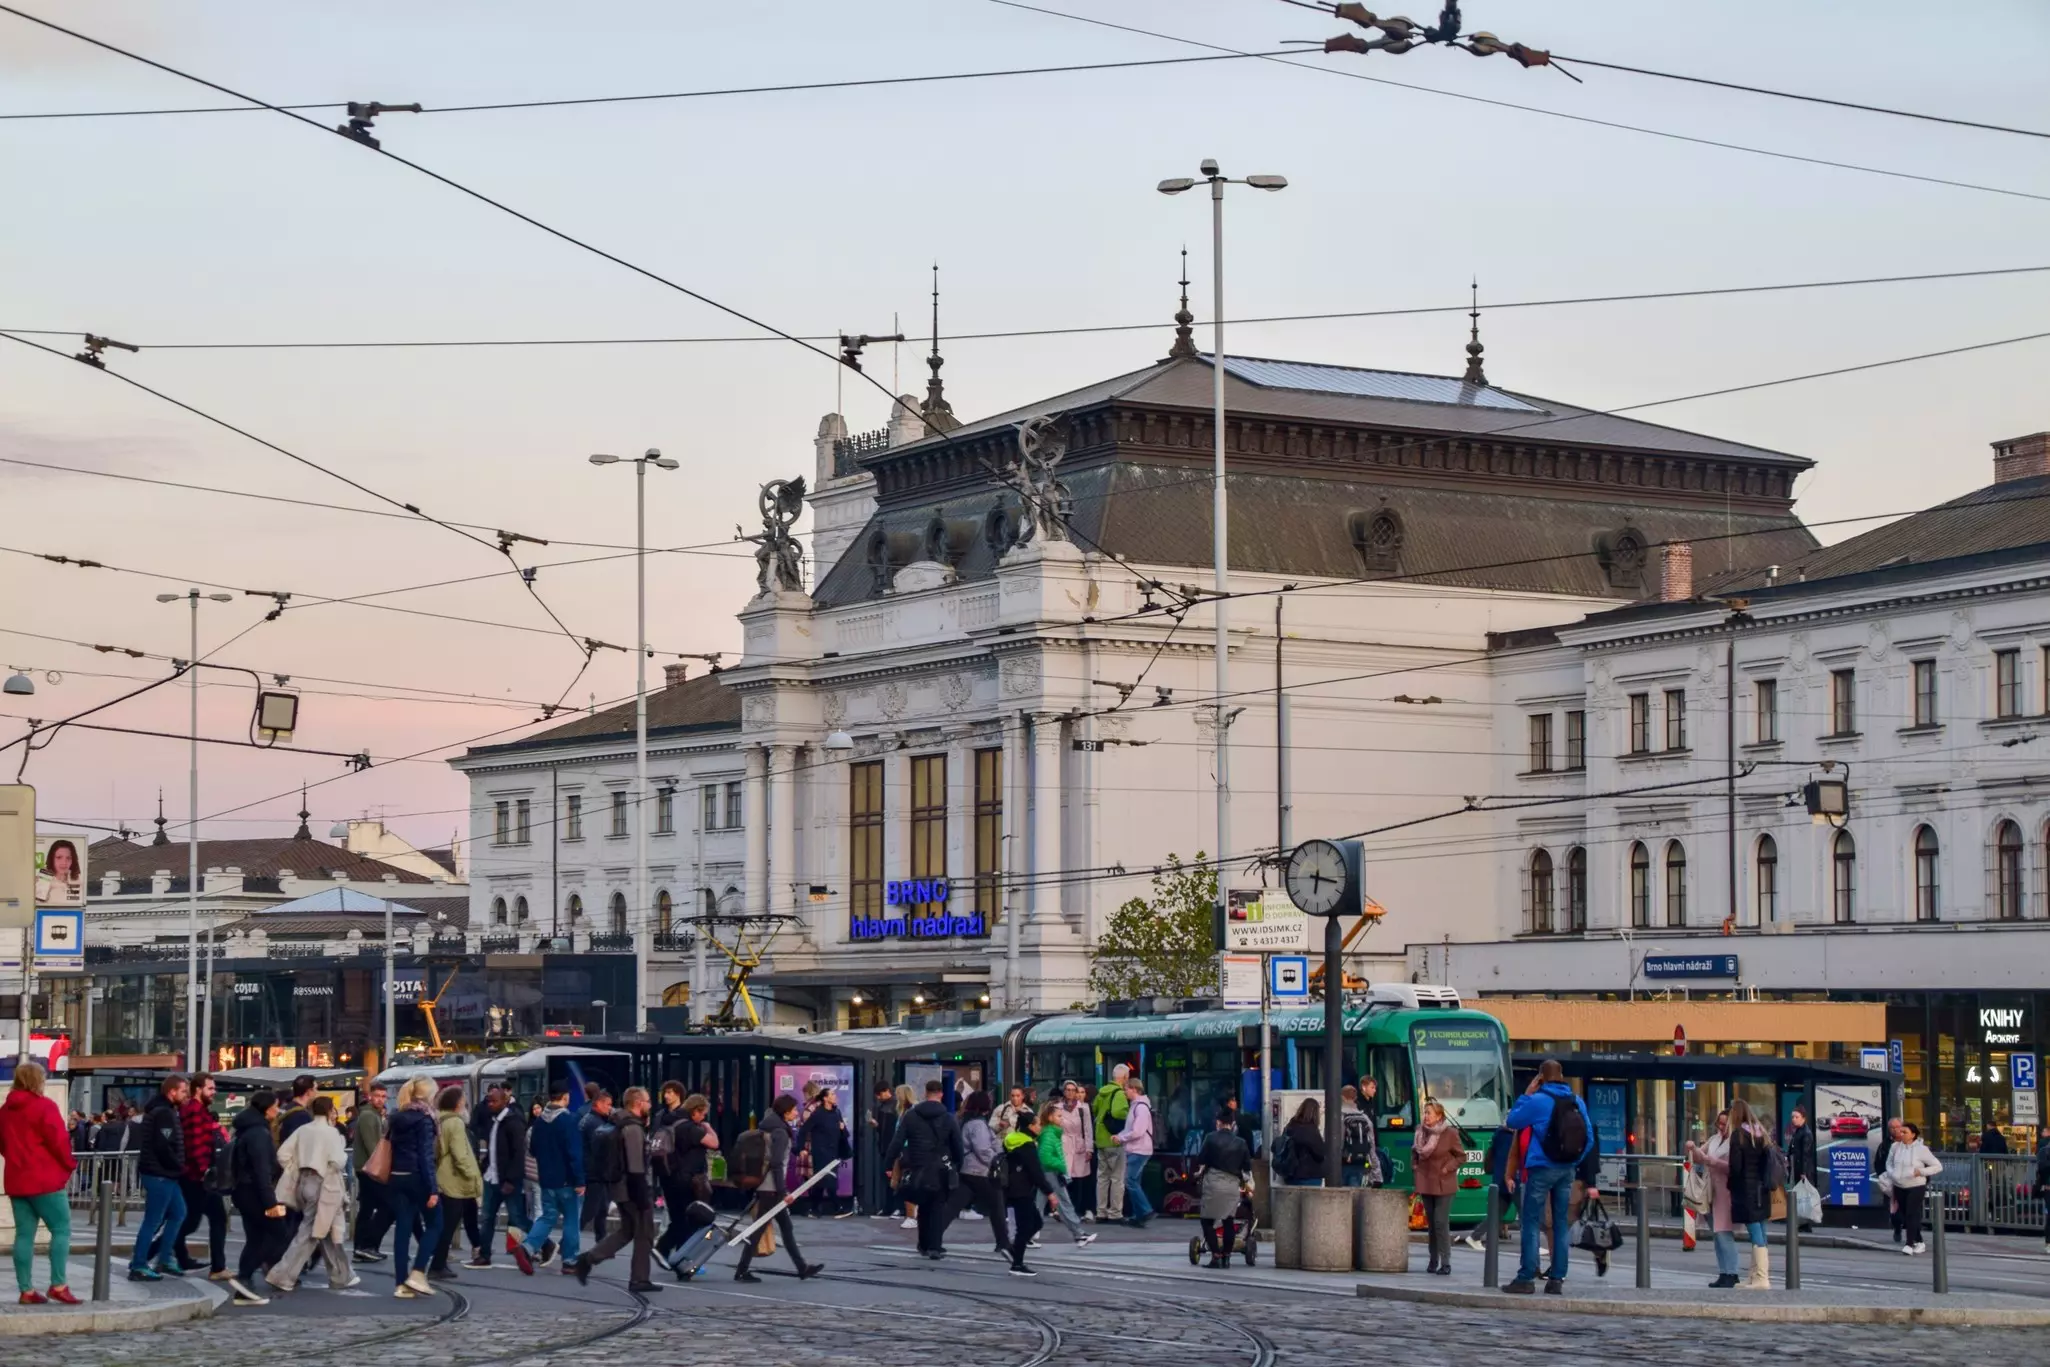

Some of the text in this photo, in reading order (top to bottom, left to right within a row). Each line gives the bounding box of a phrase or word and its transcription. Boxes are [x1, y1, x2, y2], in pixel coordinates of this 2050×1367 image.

[1082, 741, 1097, 751] 131
[887, 879, 949, 905] BRNO
[852, 910, 986, 938] hlavní nádraží
[1232, 924, 1302, 935] WWW.IDSJMK.CZ
[1281, 936, 1299, 944] 4317
[1646, 960, 1712, 971] Brno hlavní nádraží
[234, 983, 260, 994] COSTA
[293, 986, 333, 996] ROSSMANN
[1980, 1008, 2024, 1028] KNIHY
[2017, 1058, 2031, 1078] P
[1832, 1151, 1866, 1160] VÝSTAVA
